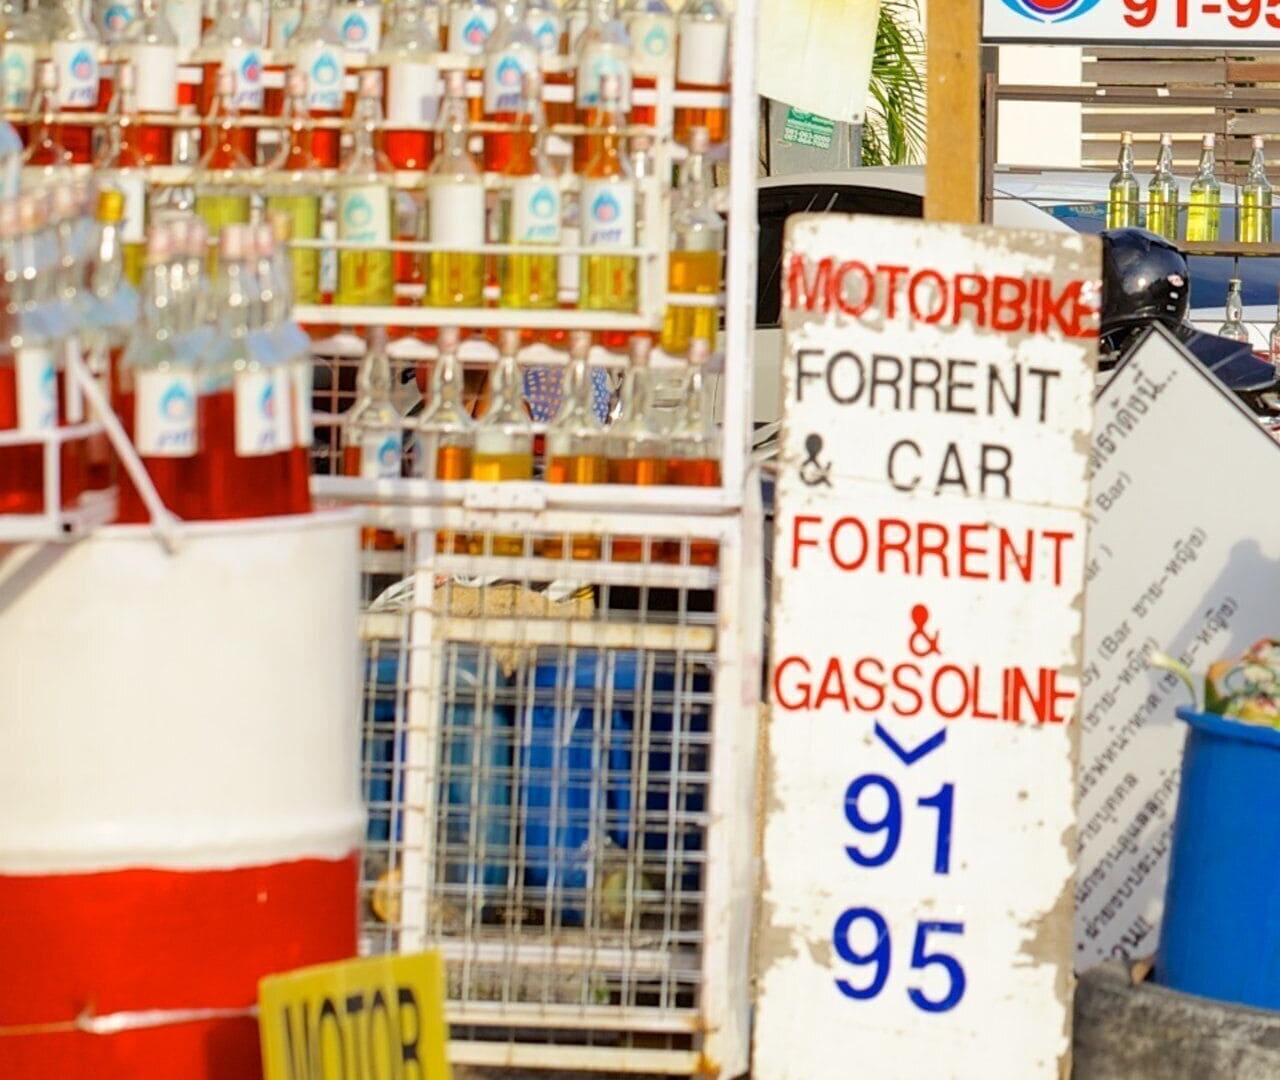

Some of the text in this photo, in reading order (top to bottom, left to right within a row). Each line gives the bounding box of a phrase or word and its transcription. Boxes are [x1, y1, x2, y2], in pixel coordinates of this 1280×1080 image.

[795, 347, 1061, 423] FORRENT
[886, 438, 1014, 499] CAR
[790, 513, 1075, 587] FORRENT
[909, 603, 943, 659] &
[843, 773, 955, 875] 91
[833, 905, 967, 1014] 95
[284, 986, 426, 1080] MOTOR
